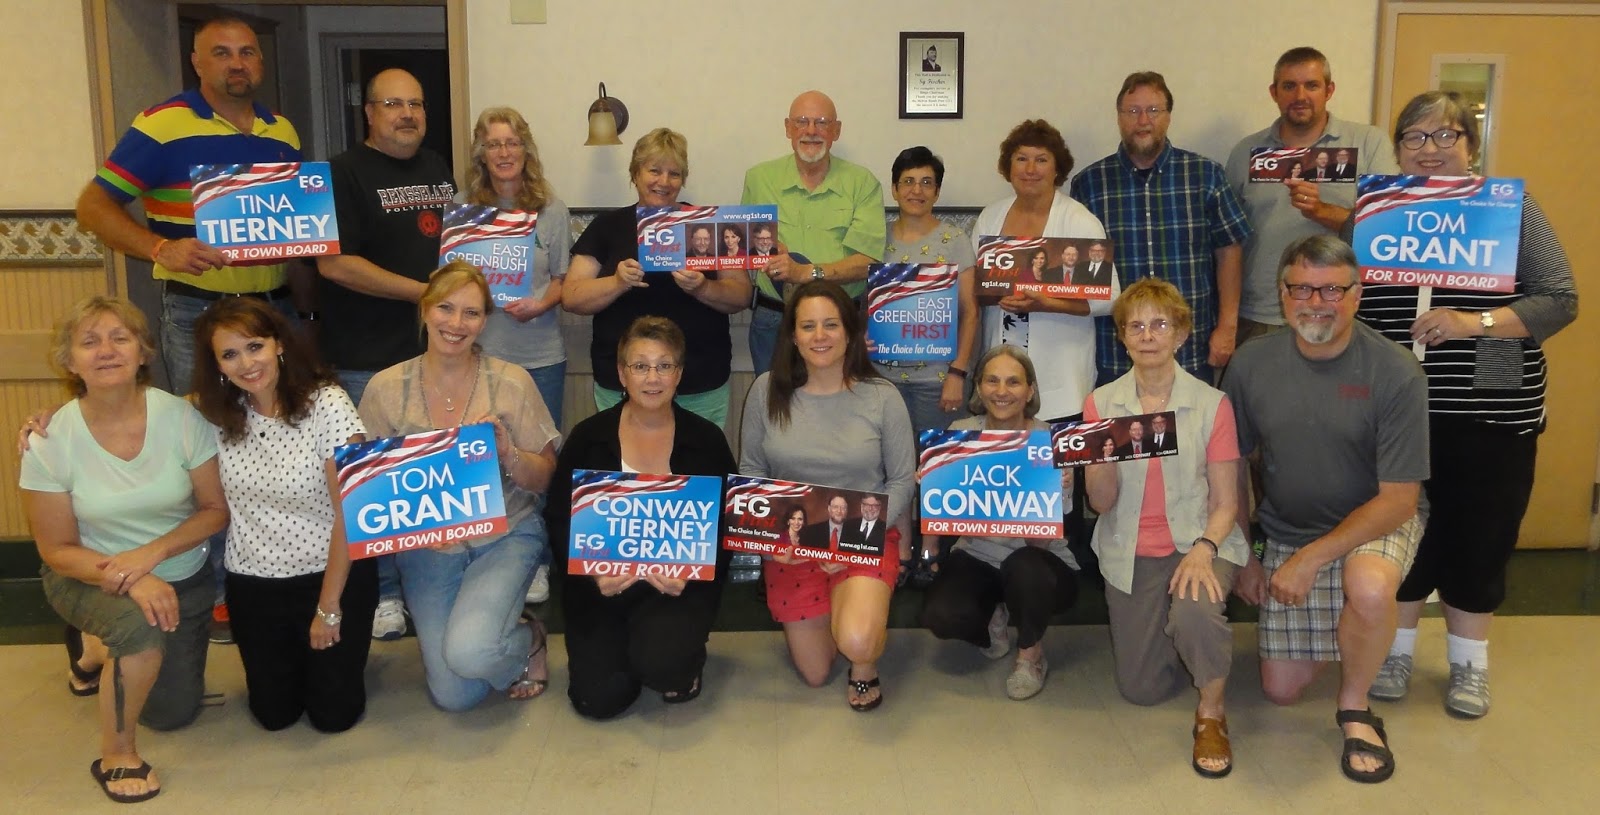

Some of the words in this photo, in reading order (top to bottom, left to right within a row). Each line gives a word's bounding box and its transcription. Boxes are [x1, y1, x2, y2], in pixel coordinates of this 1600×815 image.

[1255, 158, 1278, 170] EG
[299, 175, 324, 188] EG
[1491, 184, 1514, 196] EG
[236, 194, 295, 214] TINA
[202, 214, 330, 244] TIERNEY
[1404, 211, 1466, 234] TOM
[644, 229, 675, 246] EG
[222, 249, 239, 259] OR
[243, 246, 282, 258] TOWN
[286, 244, 328, 256] BOARD
[493, 243, 529, 257] EAST
[1370, 234, 1499, 267] GRANT
[983, 253, 1014, 270] EG
[1365, 270, 1393, 282] FOR
[1397, 272, 1443, 284] TOWN
[1446, 274, 1498, 288] BOARD
[918, 298, 952, 309] EAST
[873, 310, 951, 323] GREENBUSH
[902, 324, 950, 339] FIRST
[878, 343, 889, 353] The
[892, 344, 912, 354] Choice
[915, 344, 925, 353] for
[926, 344, 951, 356] Change
[458, 440, 487, 459] EG
[1058, 435, 1086, 452] EG
[1027, 446, 1053, 461] EG
[386, 463, 455, 495] TOM
[960, 465, 1022, 487] JACK
[357, 484, 491, 535] GRANT
[592, 496, 714, 520] CONWAY
[733, 494, 770, 518] EG
[923, 488, 1060, 518] CONWAY
[606, 517, 713, 540] TIERNEY
[762, 531, 780, 539] Change
[927, 522, 949, 532] FOR
[952, 522, 987, 533] TOWN
[990, 524, 1057, 536] SUPERVISOR
[366, 540, 394, 555] FOR
[397, 531, 442, 549] TOWN
[446, 522, 494, 540] BOARD
[574, 534, 605, 550] EG
[840, 542, 878, 551] www.eg1st.com
[618, 538, 711, 561] GRANT
[743, 541, 776, 553] TIERNEY
[794, 548, 833, 560] CONWAY
[850, 555, 881, 566] GRANT
[583, 561, 631, 575] VOTE
[636, 563, 685, 578] ROW
[687, 566, 703, 579] X
